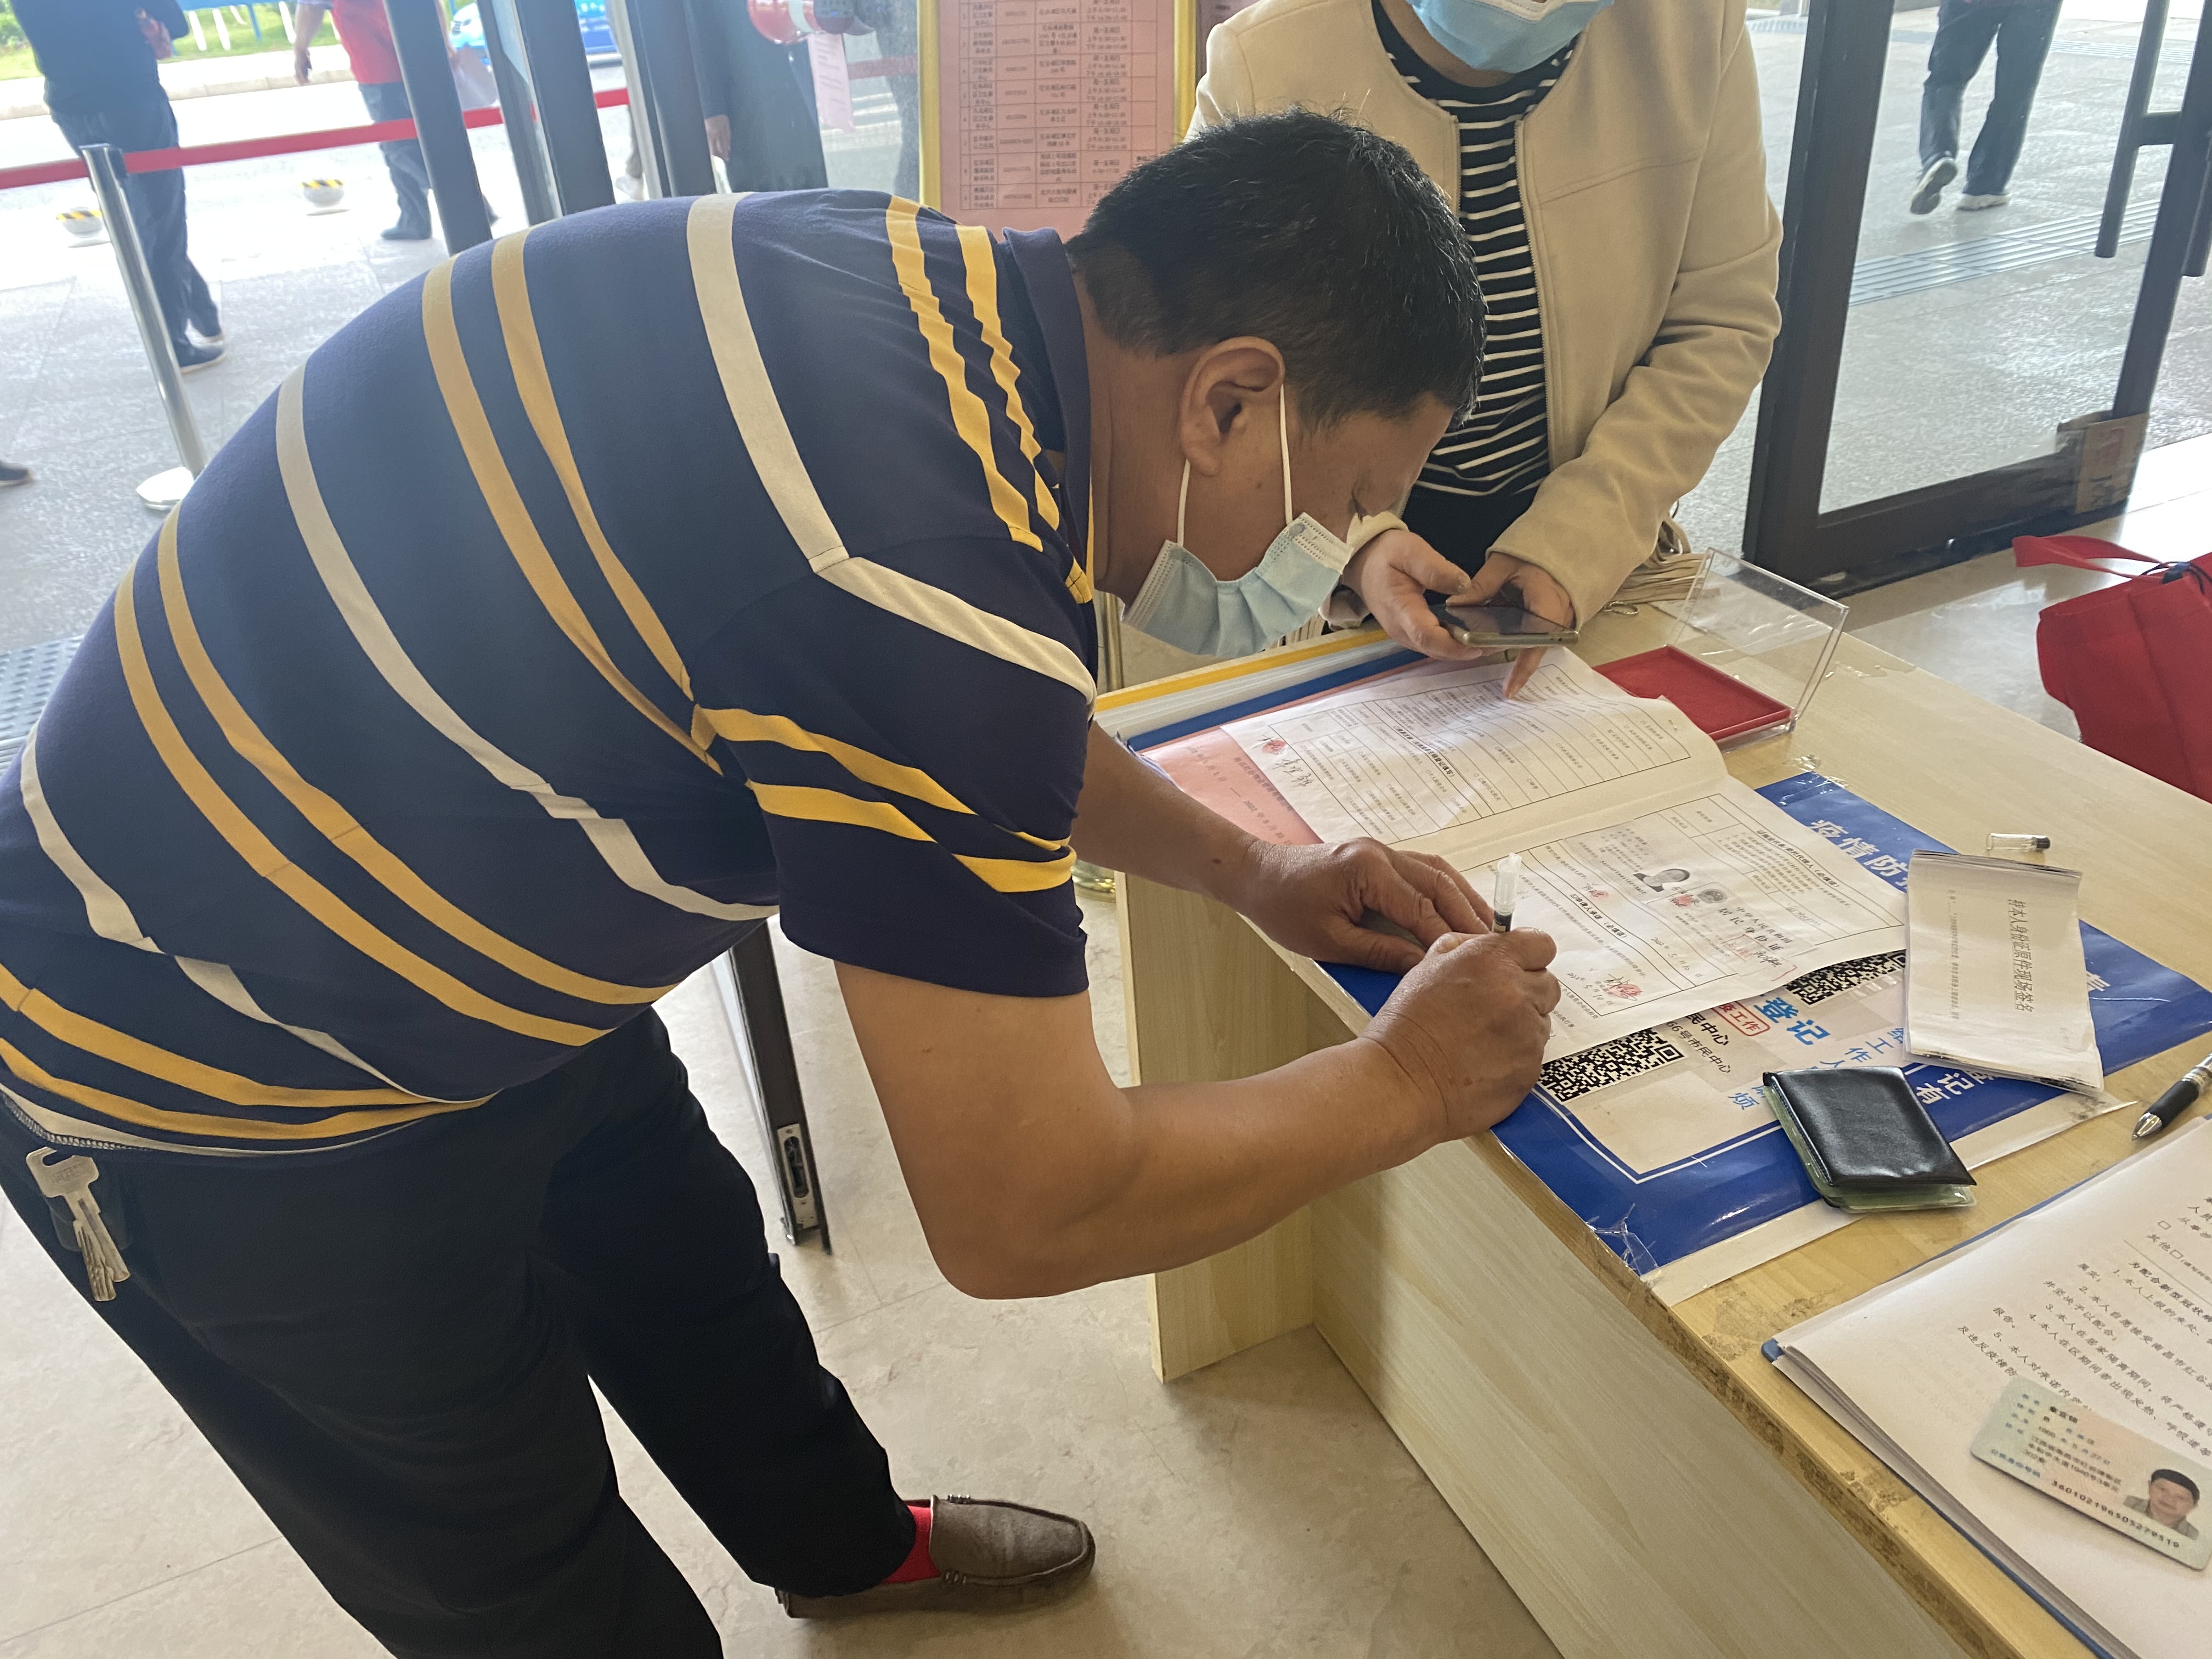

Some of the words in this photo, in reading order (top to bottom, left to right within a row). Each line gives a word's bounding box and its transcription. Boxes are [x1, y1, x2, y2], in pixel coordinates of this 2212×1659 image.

[1809, 814, 1911, 893] 疫情防
[1717, 907, 1784, 955] 居民身份证
[1735, 906, 1792, 944] 中华人民共和国
[2007, 899, 2034, 1013] 持本人身份证原件现场签名
[1753, 994, 1831, 1047] 登记
